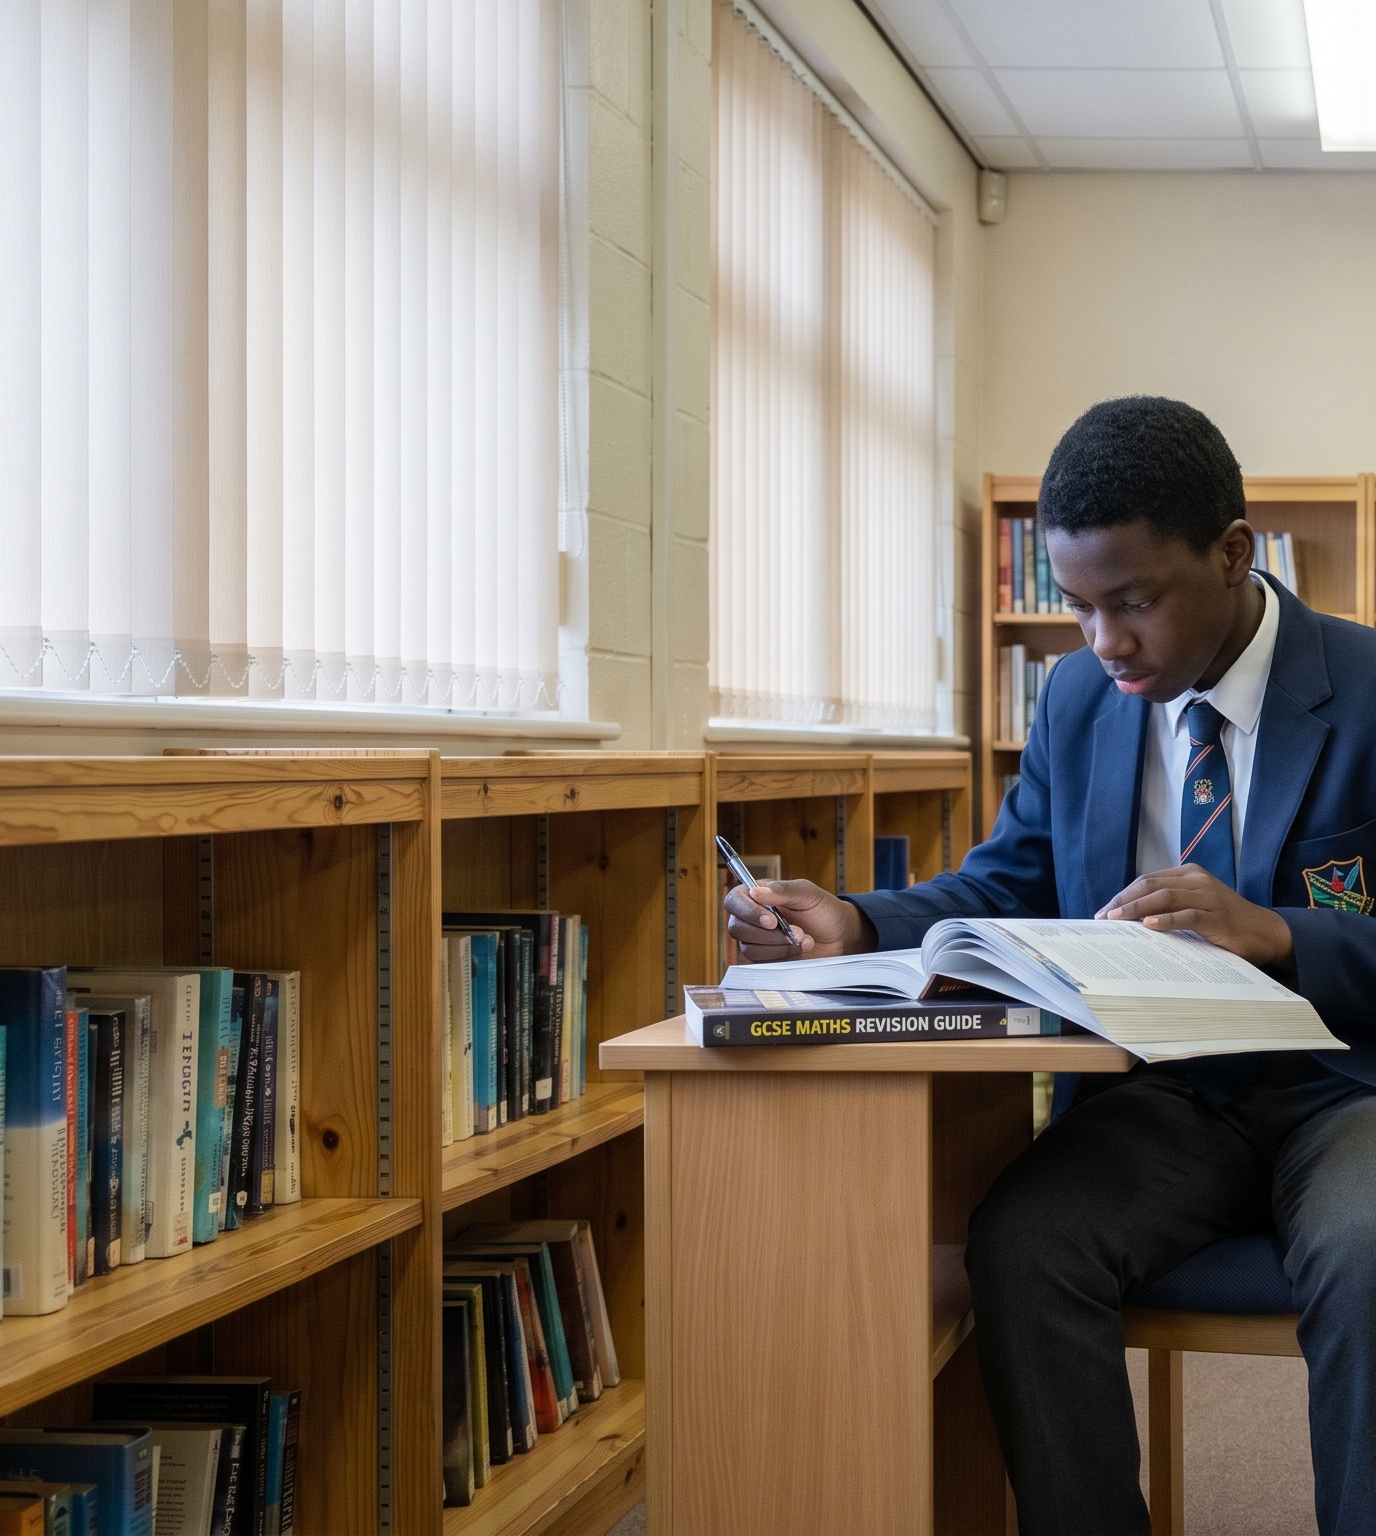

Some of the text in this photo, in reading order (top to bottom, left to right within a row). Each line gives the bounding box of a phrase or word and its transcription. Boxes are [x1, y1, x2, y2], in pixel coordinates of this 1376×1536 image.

[750, 1014, 982, 1037] GCSE MATHS REVISION GUIDE
